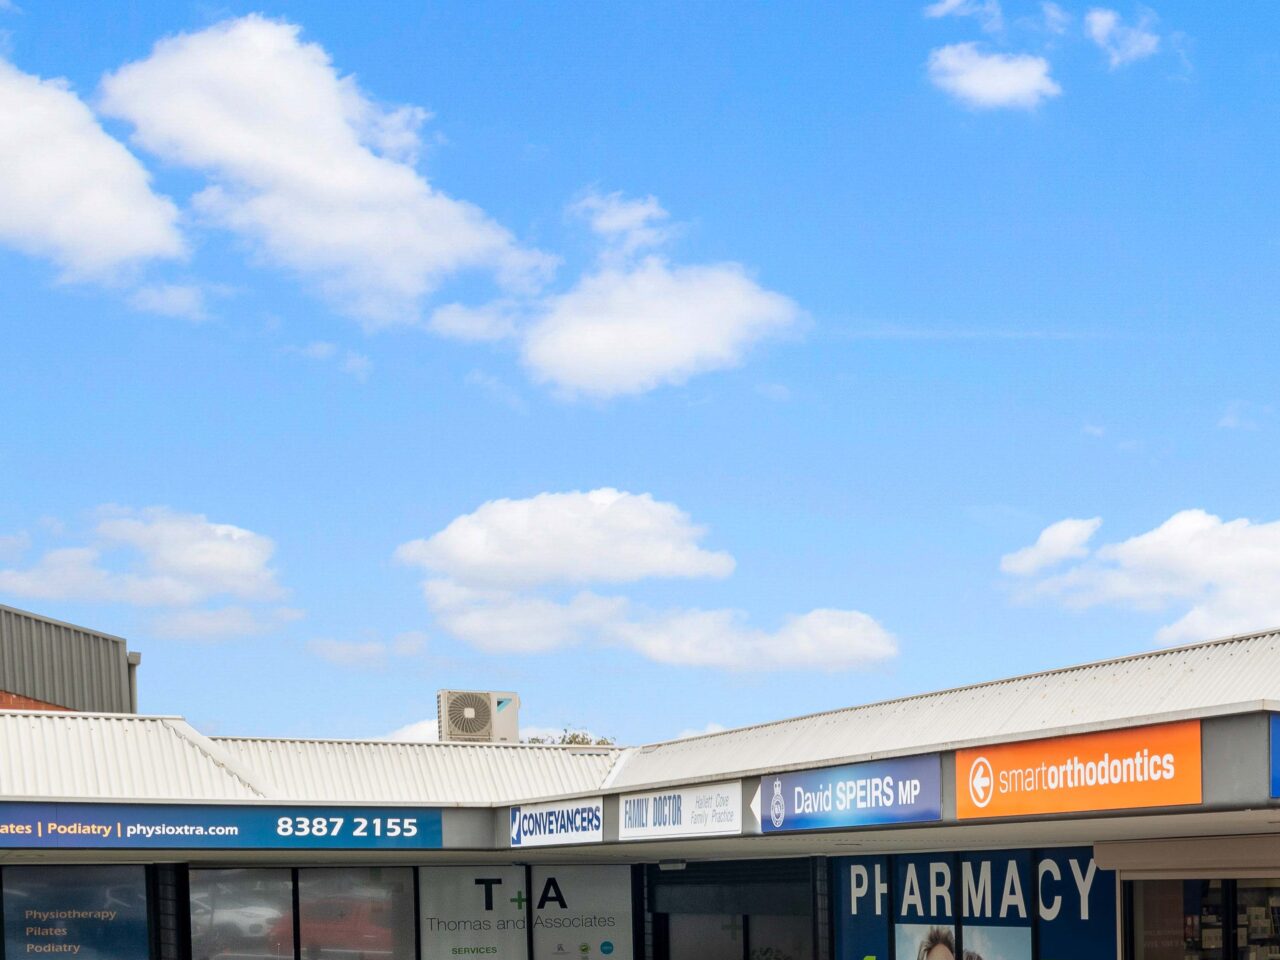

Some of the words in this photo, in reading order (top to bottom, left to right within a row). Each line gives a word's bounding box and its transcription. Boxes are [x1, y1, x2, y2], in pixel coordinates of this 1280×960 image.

[998, 749, 1175, 793] smartorthodontics
[695, 795, 713, 808] Hallett
[716, 793, 729, 807] Cove
[794, 783, 832, 814] David
[835, 776, 894, 810] SPEIRS
[898, 778, 920, 804] MP
[624, 797, 650, 829] FAMILY
[652, 794, 682, 828] DOCTOR
[690, 810, 709, 826] Family
[47, 823, 112, 837] Podiatry
[126, 823, 239, 836] physioxtra.com
[277, 816, 344, 837] 8387
[352, 817, 418, 837] 2155
[521, 806, 600, 836] CONVEYANCERS
[474, 878, 502, 911] T
[537, 877, 568, 909] A
[850, 859, 1097, 921] PHARMACY
[25, 909, 117, 921] Physiotherapy
[426, 916, 492, 932] Thomas
[496, 916, 525, 931] and
[532, 914, 615, 928] Associates
[26, 927, 67, 936] Pilates
[26, 943, 80, 954] Podiatry
[452, 946, 497, 955] SERVICES
